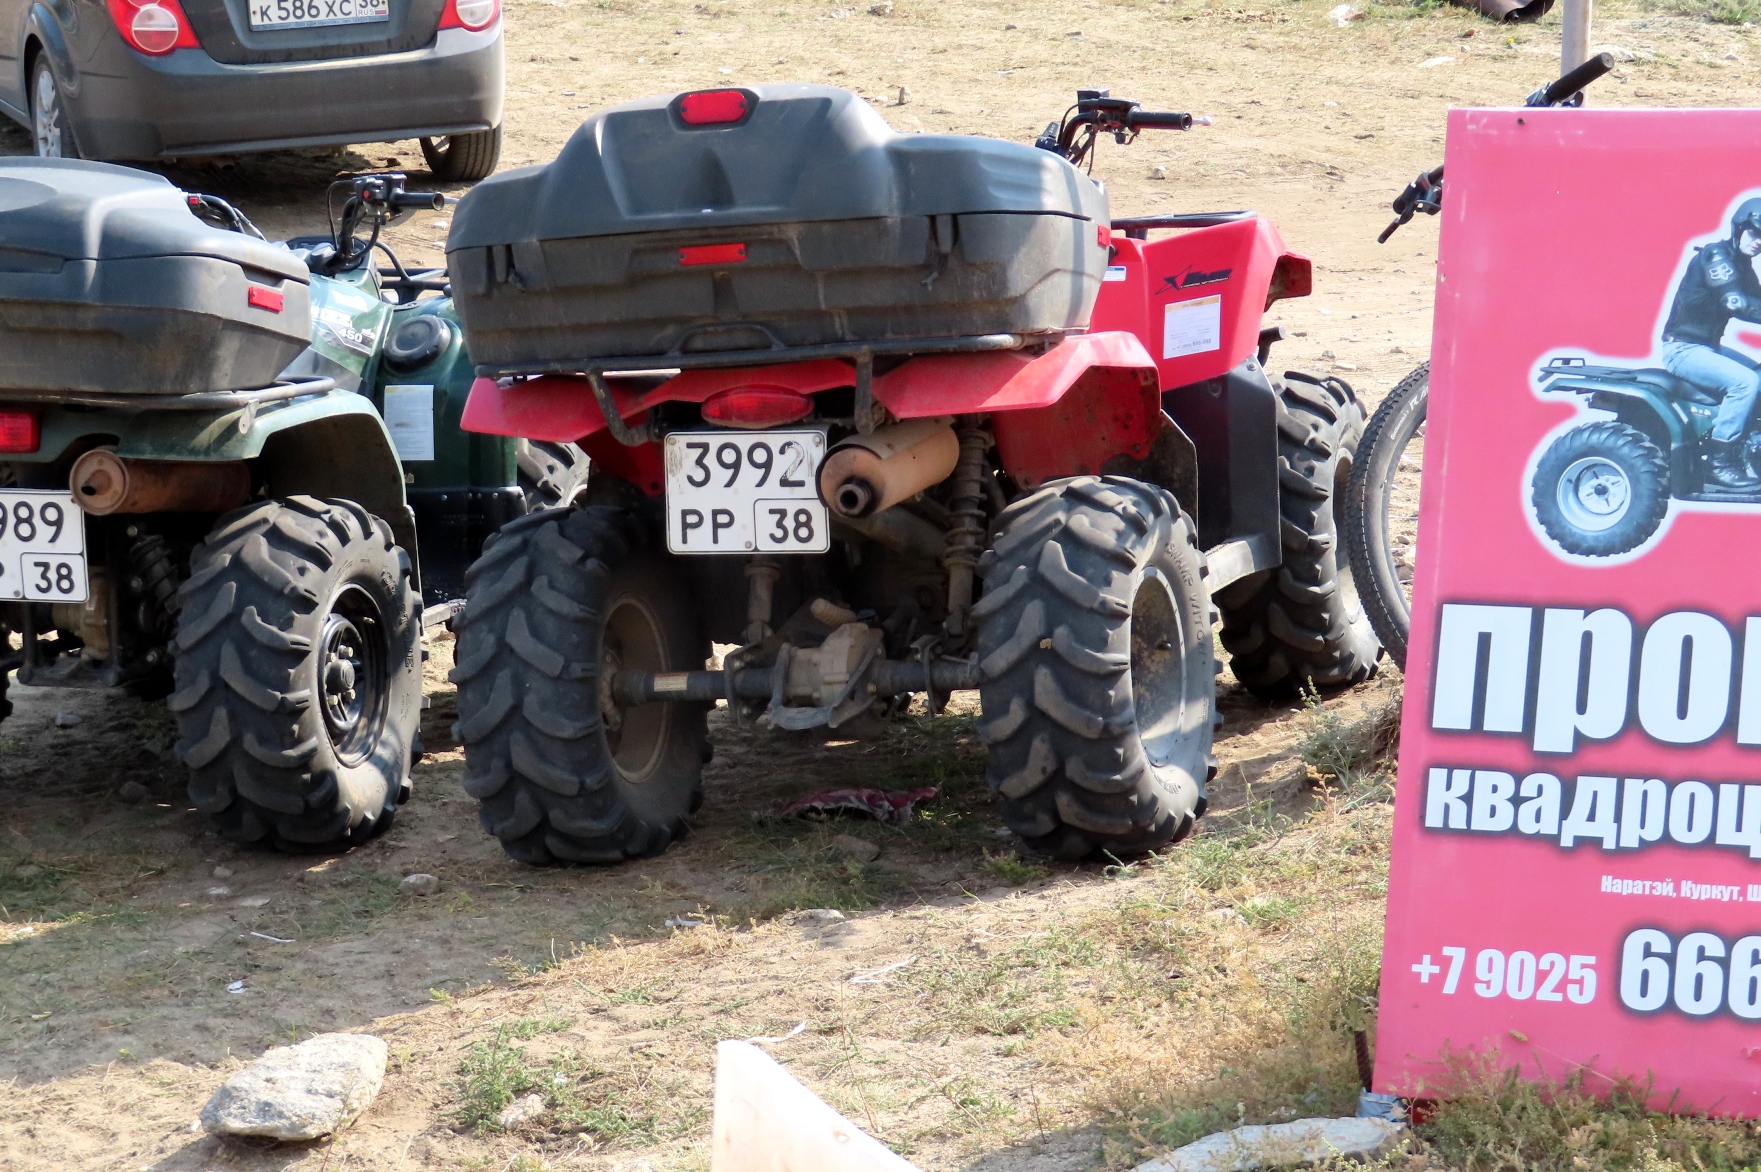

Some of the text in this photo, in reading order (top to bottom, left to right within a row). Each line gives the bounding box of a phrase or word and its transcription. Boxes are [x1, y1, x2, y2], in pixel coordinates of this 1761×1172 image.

[338, 328, 363, 343] 450
[686, 441, 806, 488] 3992
[681, 508, 814, 544] РР 38
[33, 561, 75, 594] 38
[1432, 604, 1761, 753] про
[1601, 875, 1676, 898] Наратэй,
[1680, 880, 1743, 902] Куркут,
[1412, 946, 1466, 994] +7
[1474, 948, 1596, 1004] 9025
